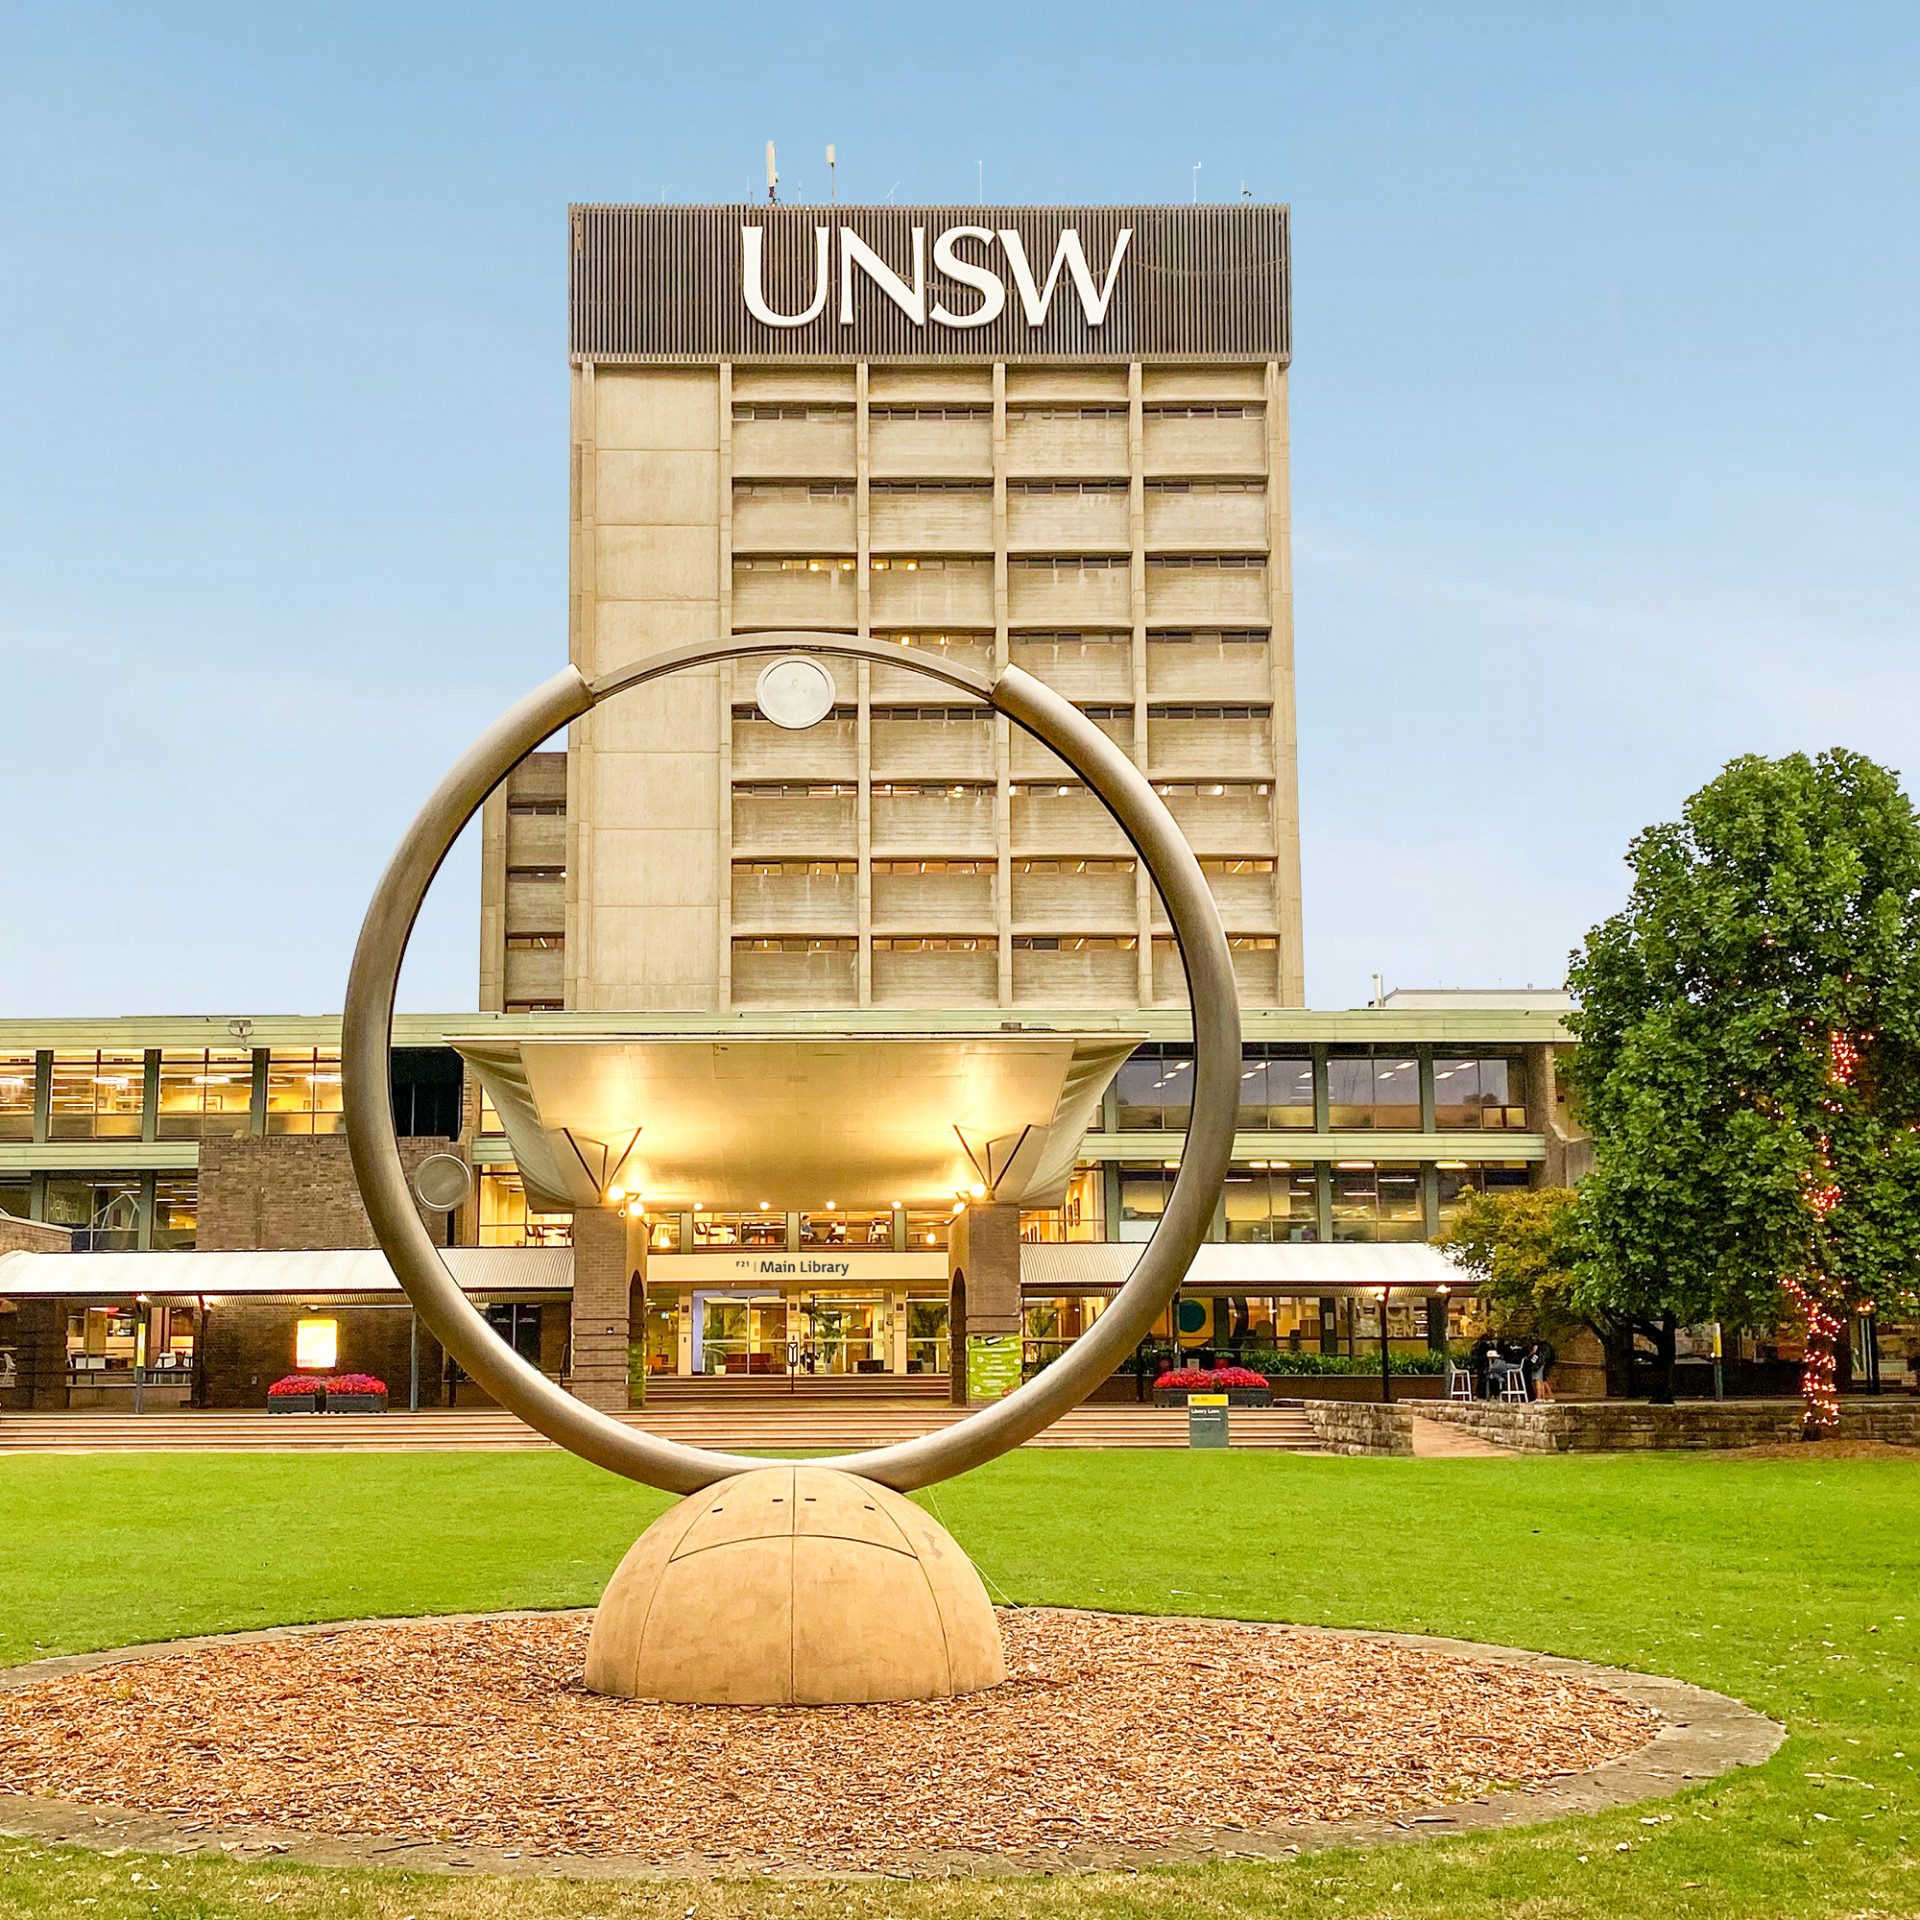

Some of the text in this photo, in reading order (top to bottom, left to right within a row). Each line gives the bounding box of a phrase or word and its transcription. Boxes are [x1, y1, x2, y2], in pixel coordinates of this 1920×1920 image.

[742, 225, 1133, 328] UNSW
[760, 1260, 796, 1273] Main
[800, 1260, 849, 1276] Library
